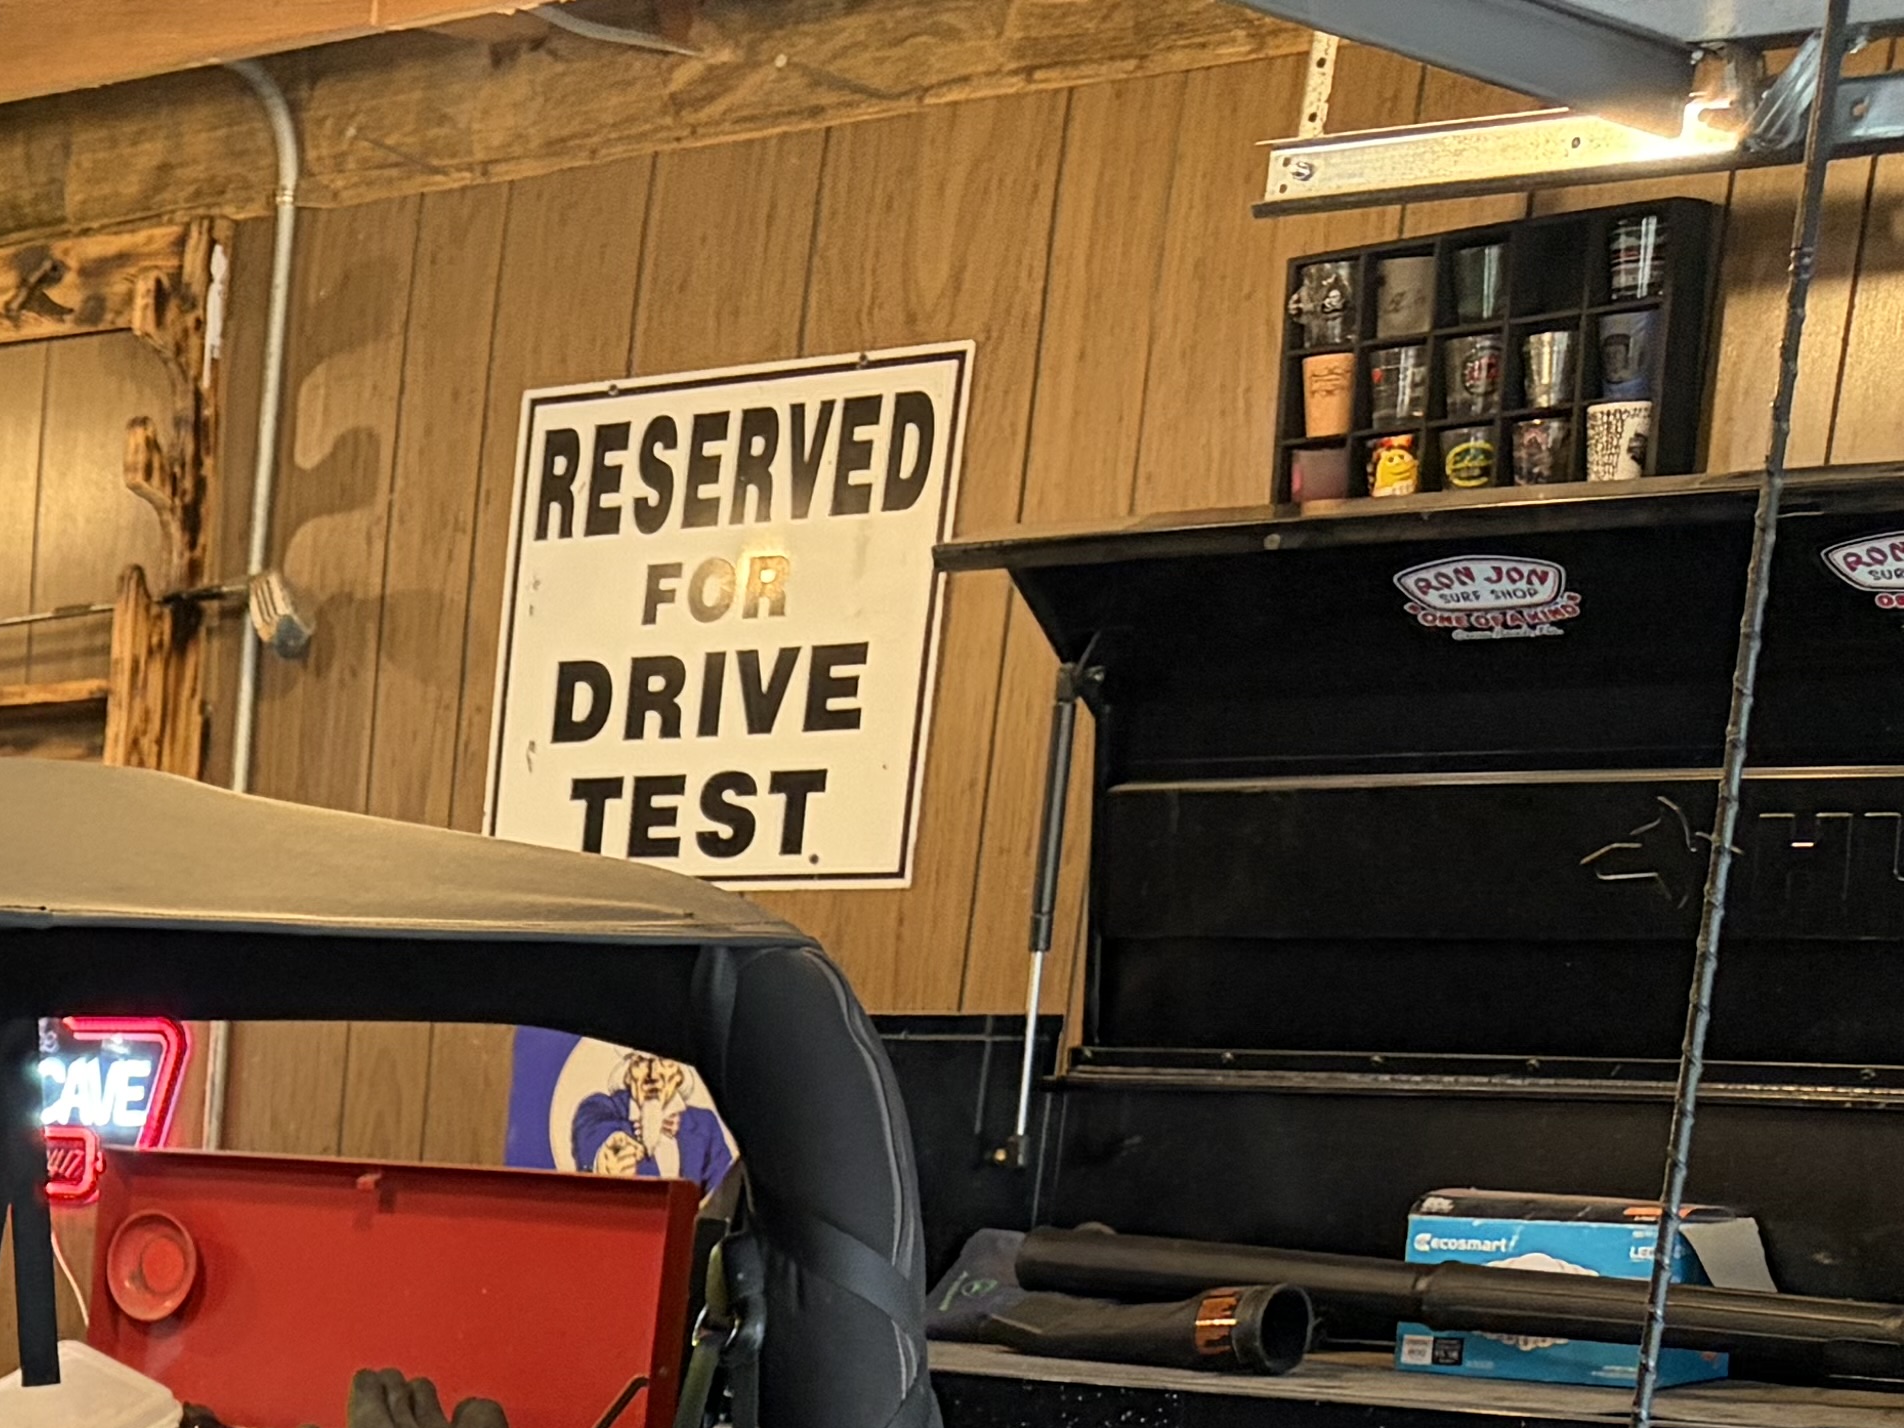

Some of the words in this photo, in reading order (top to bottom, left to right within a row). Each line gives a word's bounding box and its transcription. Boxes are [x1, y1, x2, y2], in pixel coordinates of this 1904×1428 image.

[534, 390, 935, 541] RESERVED
[641, 554, 790, 626] FOR
[1414, 566, 1476, 596] RON
[1484, 566, 1549, 585] JON
[1418, 612, 1468, 628] ONE
[1471, 613, 1503, 628] OF
[1507, 611, 1525, 626] A
[1525, 604, 1580, 624] KIND
[1439, 590, 1481, 604] SURF
[1490, 587, 1538, 600] SHOP
[550, 641, 869, 744] DRIVE
[571, 768, 829, 860] TEST
[37, 1056, 152, 1127] CAVE
[1430, 1233, 1507, 1252] ecosmart
